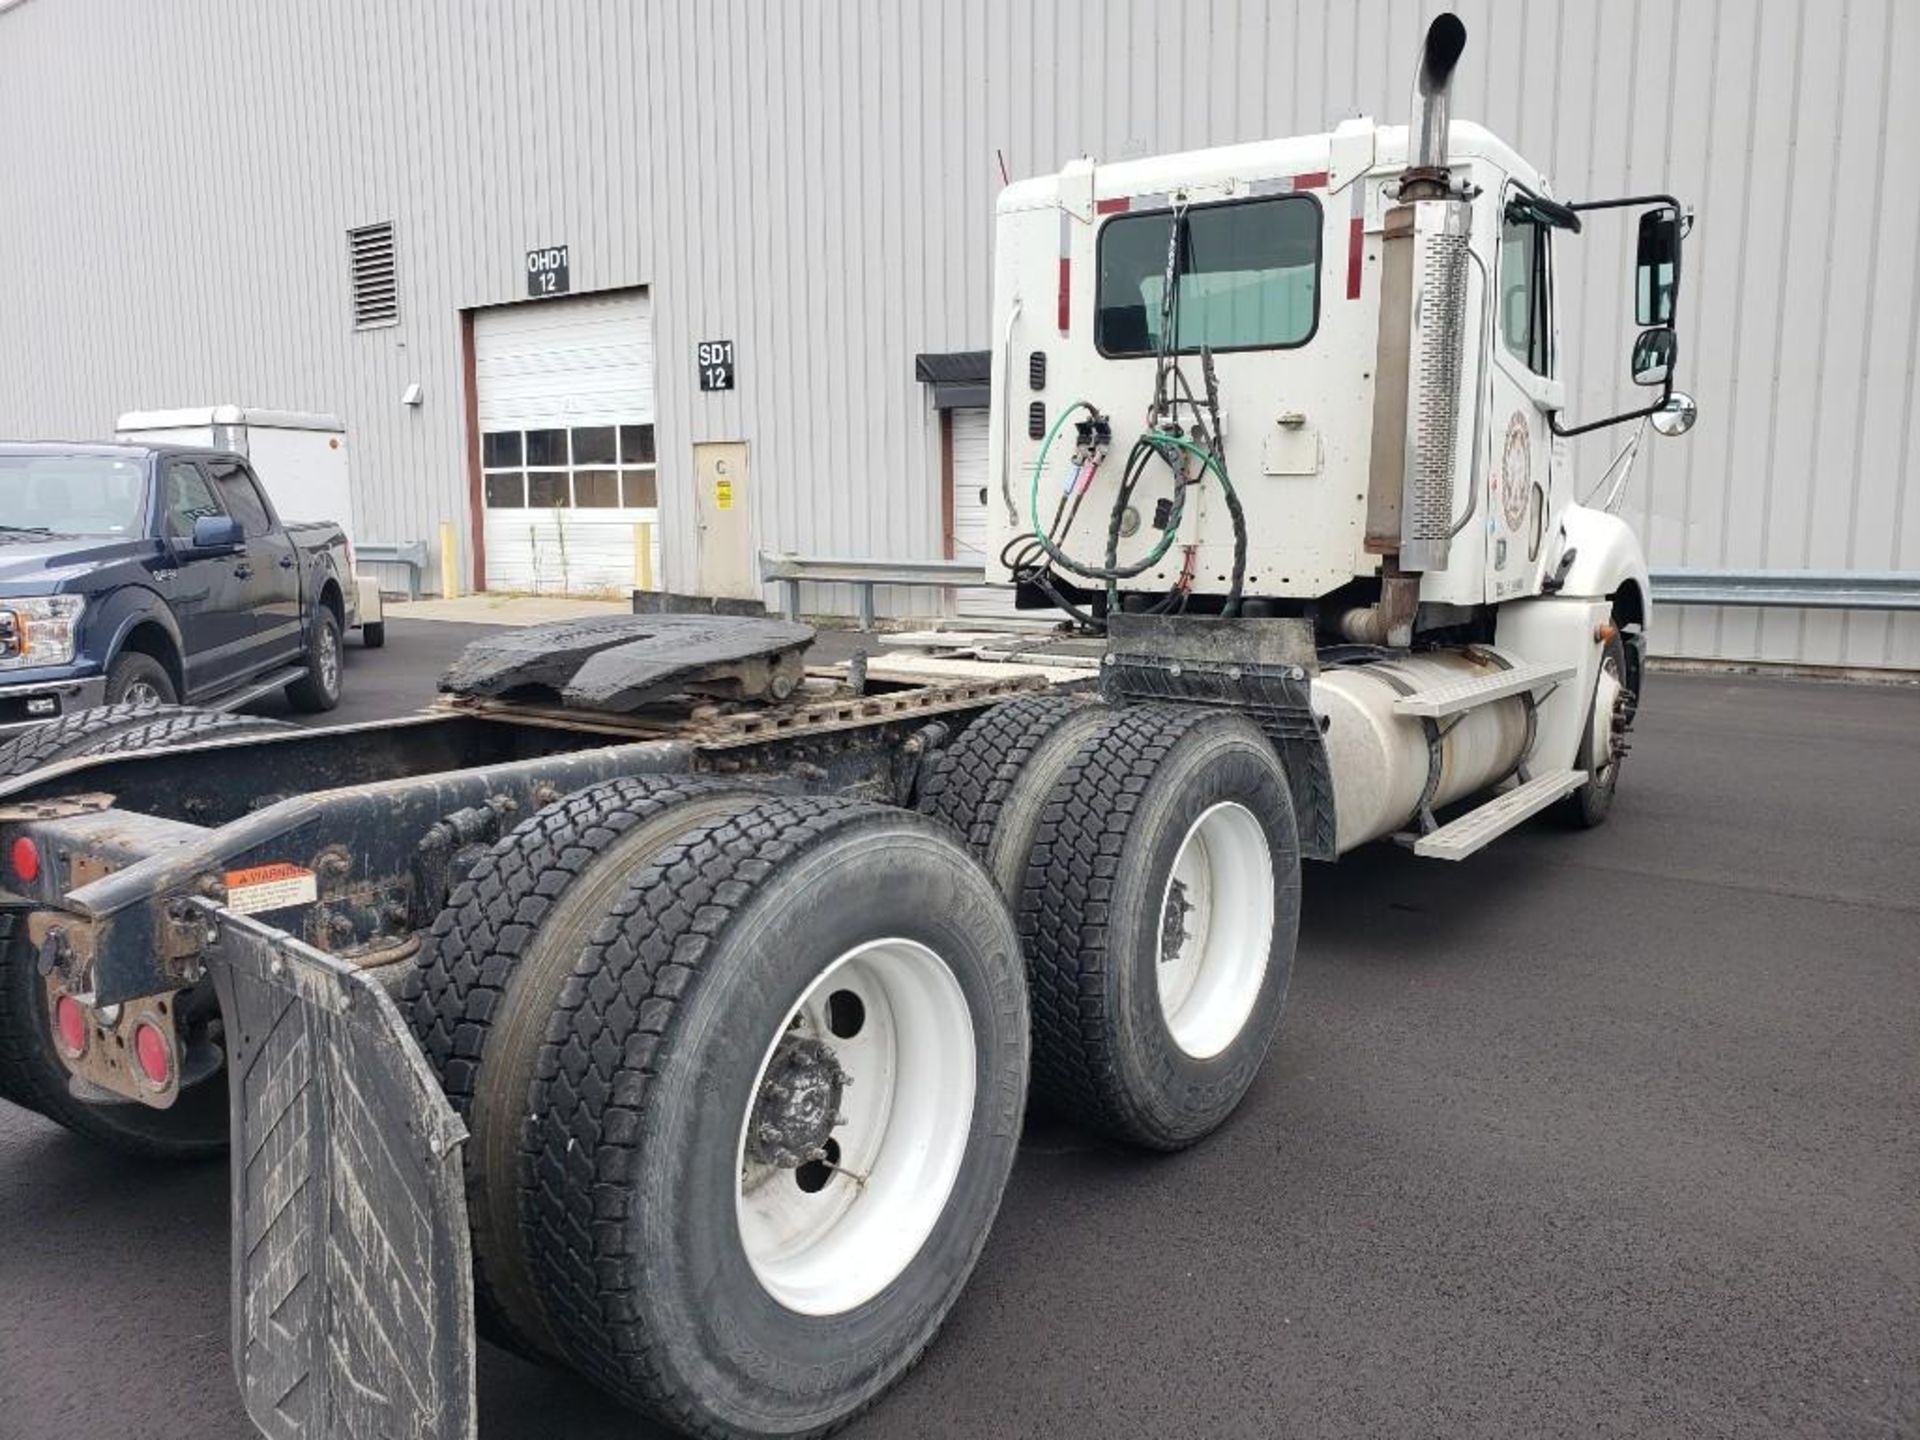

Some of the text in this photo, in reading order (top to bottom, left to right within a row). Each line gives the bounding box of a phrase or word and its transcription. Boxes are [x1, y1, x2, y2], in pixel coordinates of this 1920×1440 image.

[528, 249, 567, 272] OHD1
[539, 272, 556, 292] 12
[700, 344, 731, 366] SD1
[705, 367, 726, 388] 12
